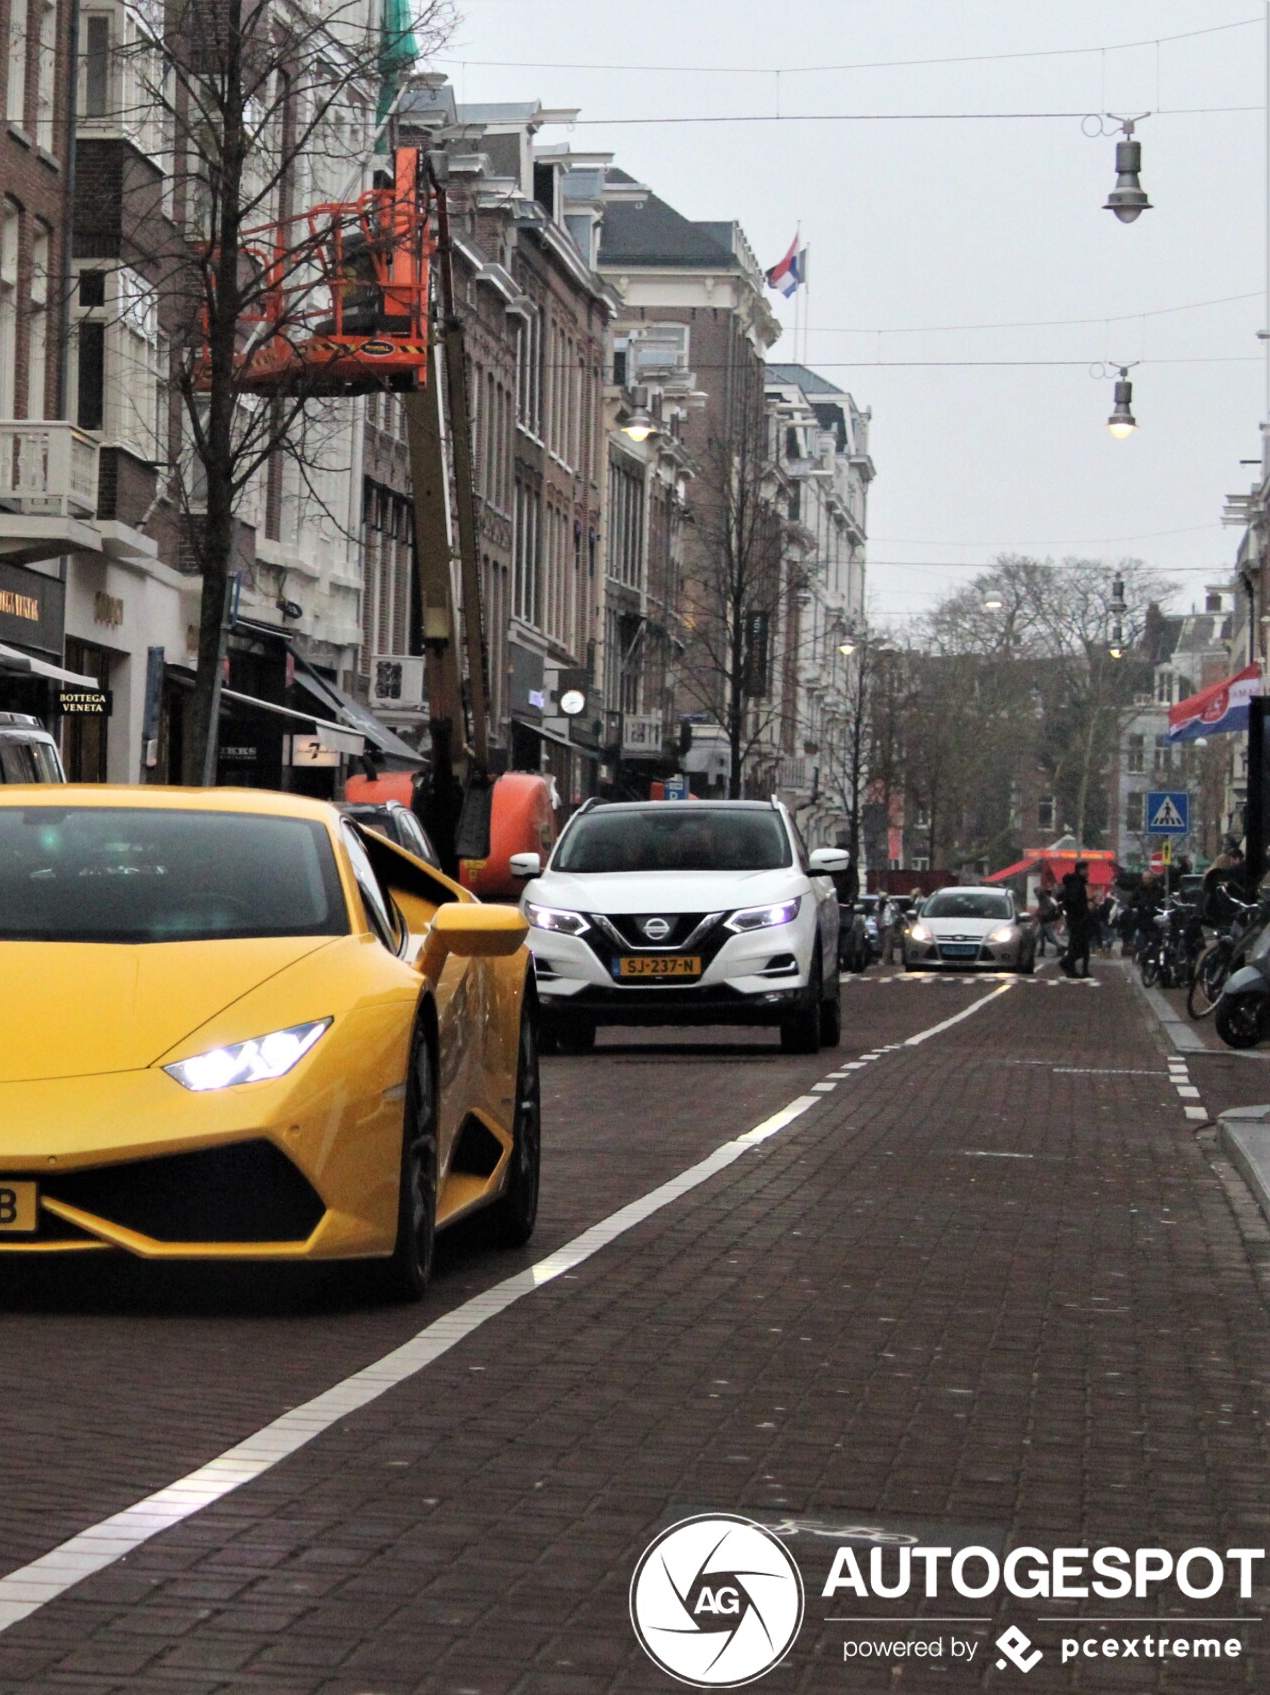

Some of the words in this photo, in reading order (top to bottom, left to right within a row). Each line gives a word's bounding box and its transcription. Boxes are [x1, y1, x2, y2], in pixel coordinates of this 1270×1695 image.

[59, 693, 106, 703] BOTTEGA
[62, 703, 103, 712] VENETA
[627, 959, 694, 973] SJ-237-N
